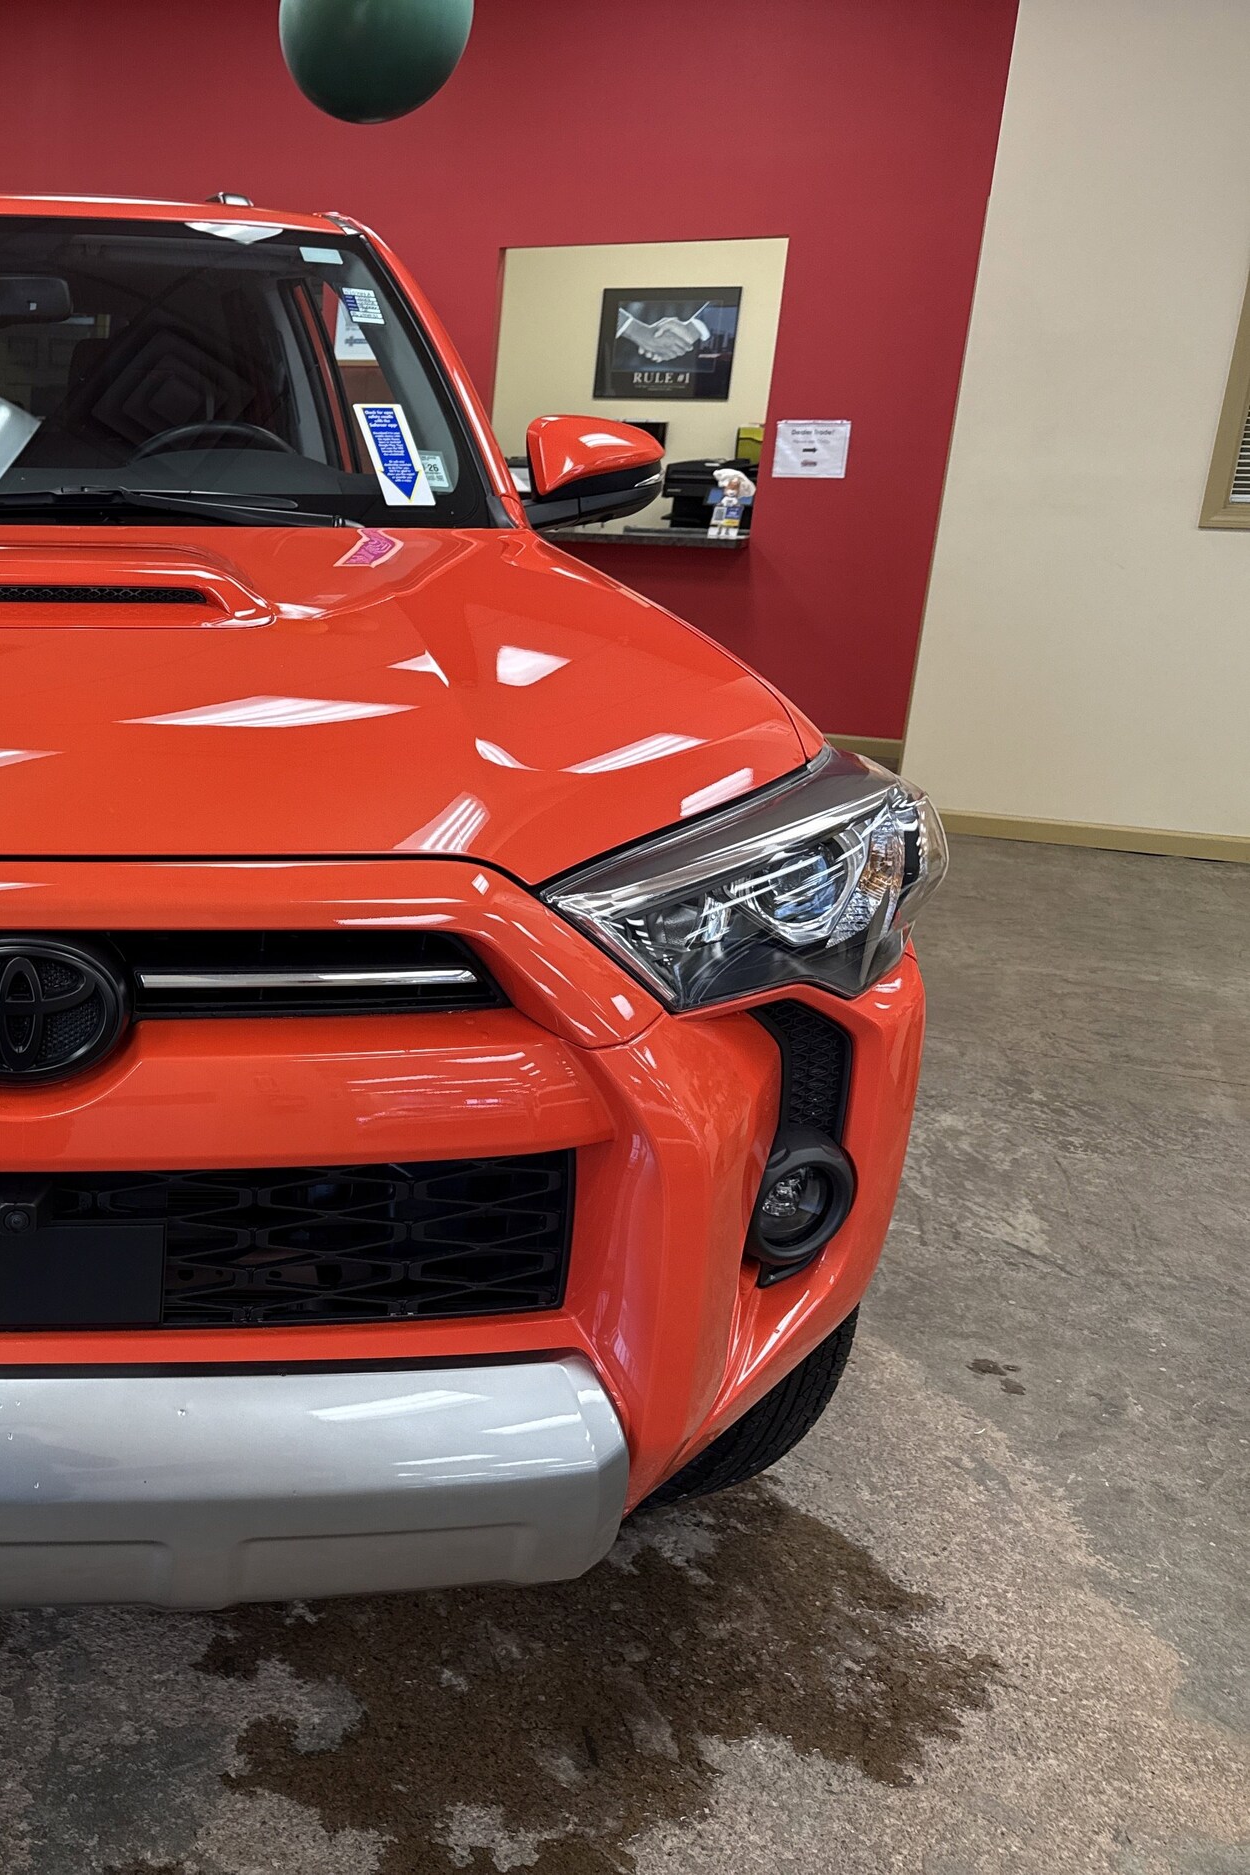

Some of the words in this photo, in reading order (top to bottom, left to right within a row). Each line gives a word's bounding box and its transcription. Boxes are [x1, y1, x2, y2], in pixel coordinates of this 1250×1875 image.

[633, 372, 674, 384] RULE
[677, 372, 690, 384] #1
[427, 463, 440, 474] 26
